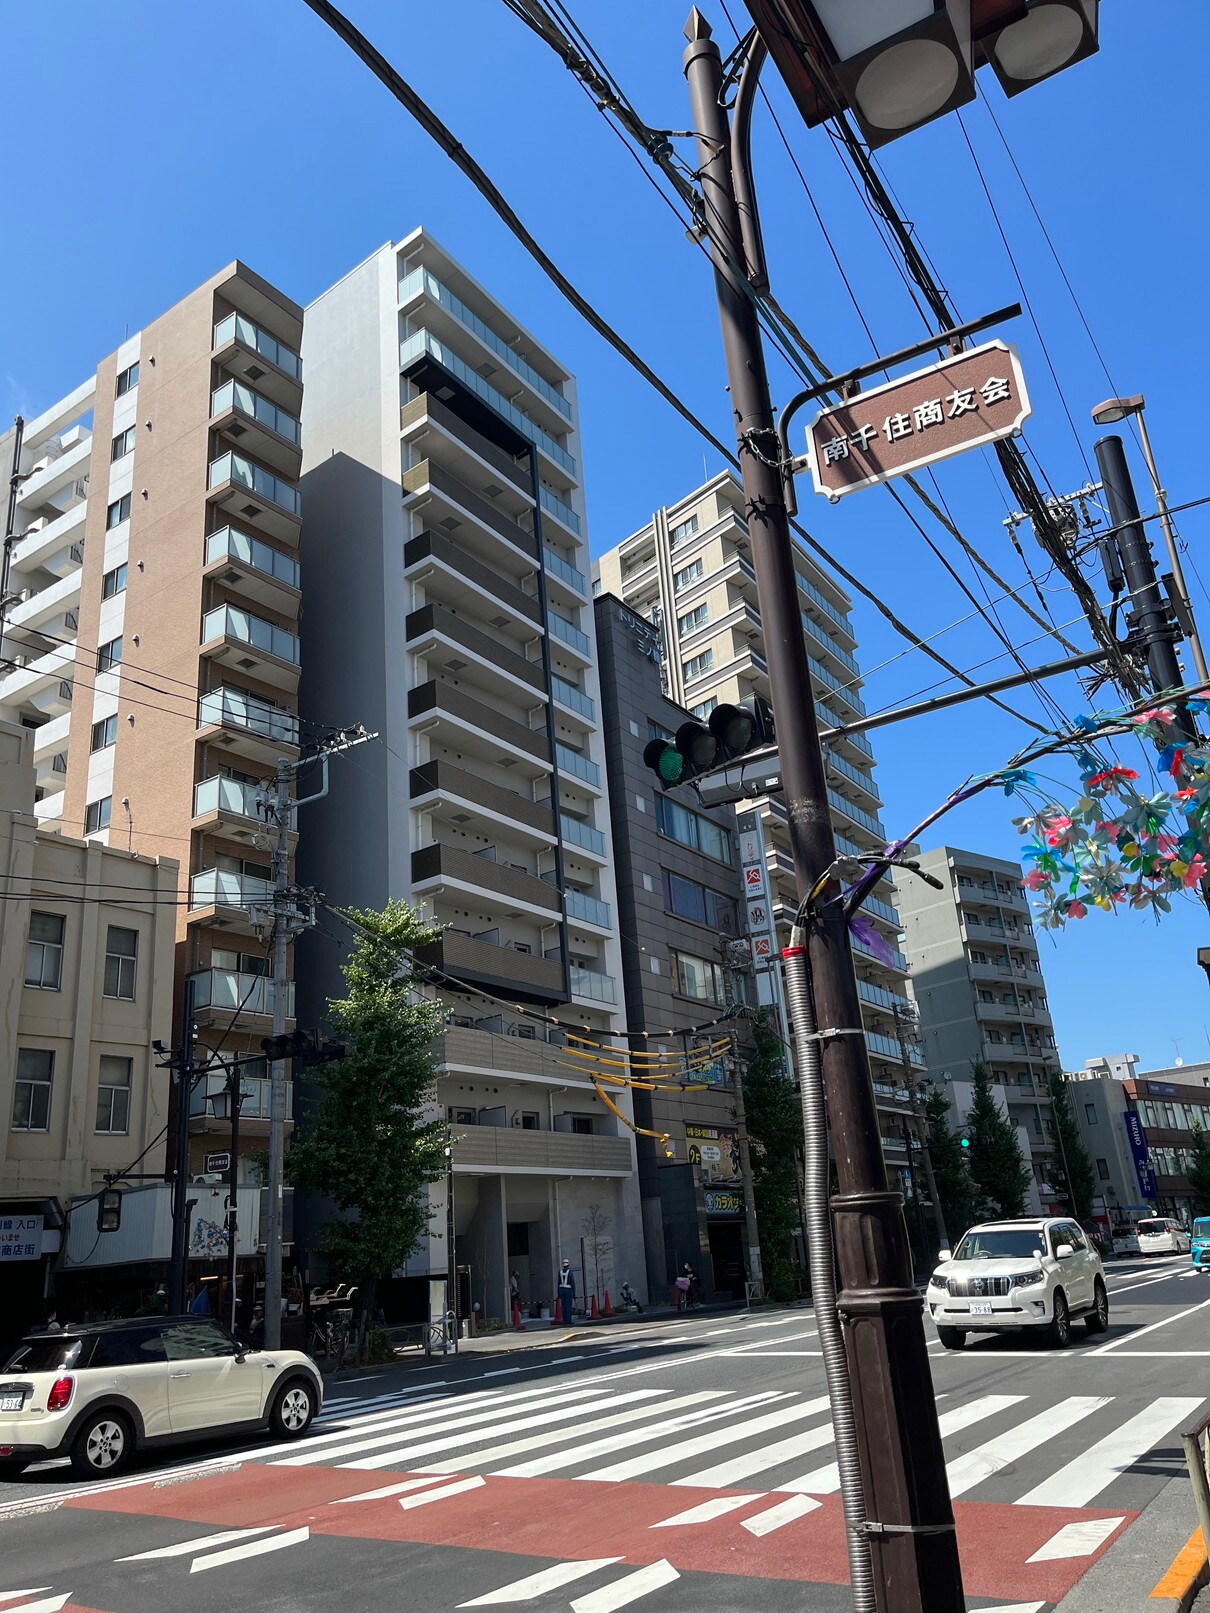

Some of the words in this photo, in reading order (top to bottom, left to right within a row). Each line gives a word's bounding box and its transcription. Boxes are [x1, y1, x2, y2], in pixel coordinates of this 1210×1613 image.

[820, 376, 1011, 466] 南千住商友会
[1129, 1116, 1142, 1146] MIZUHO
[16, 1220, 36, 1230] 入口
[0, 1233, 20, 1242] いませ
